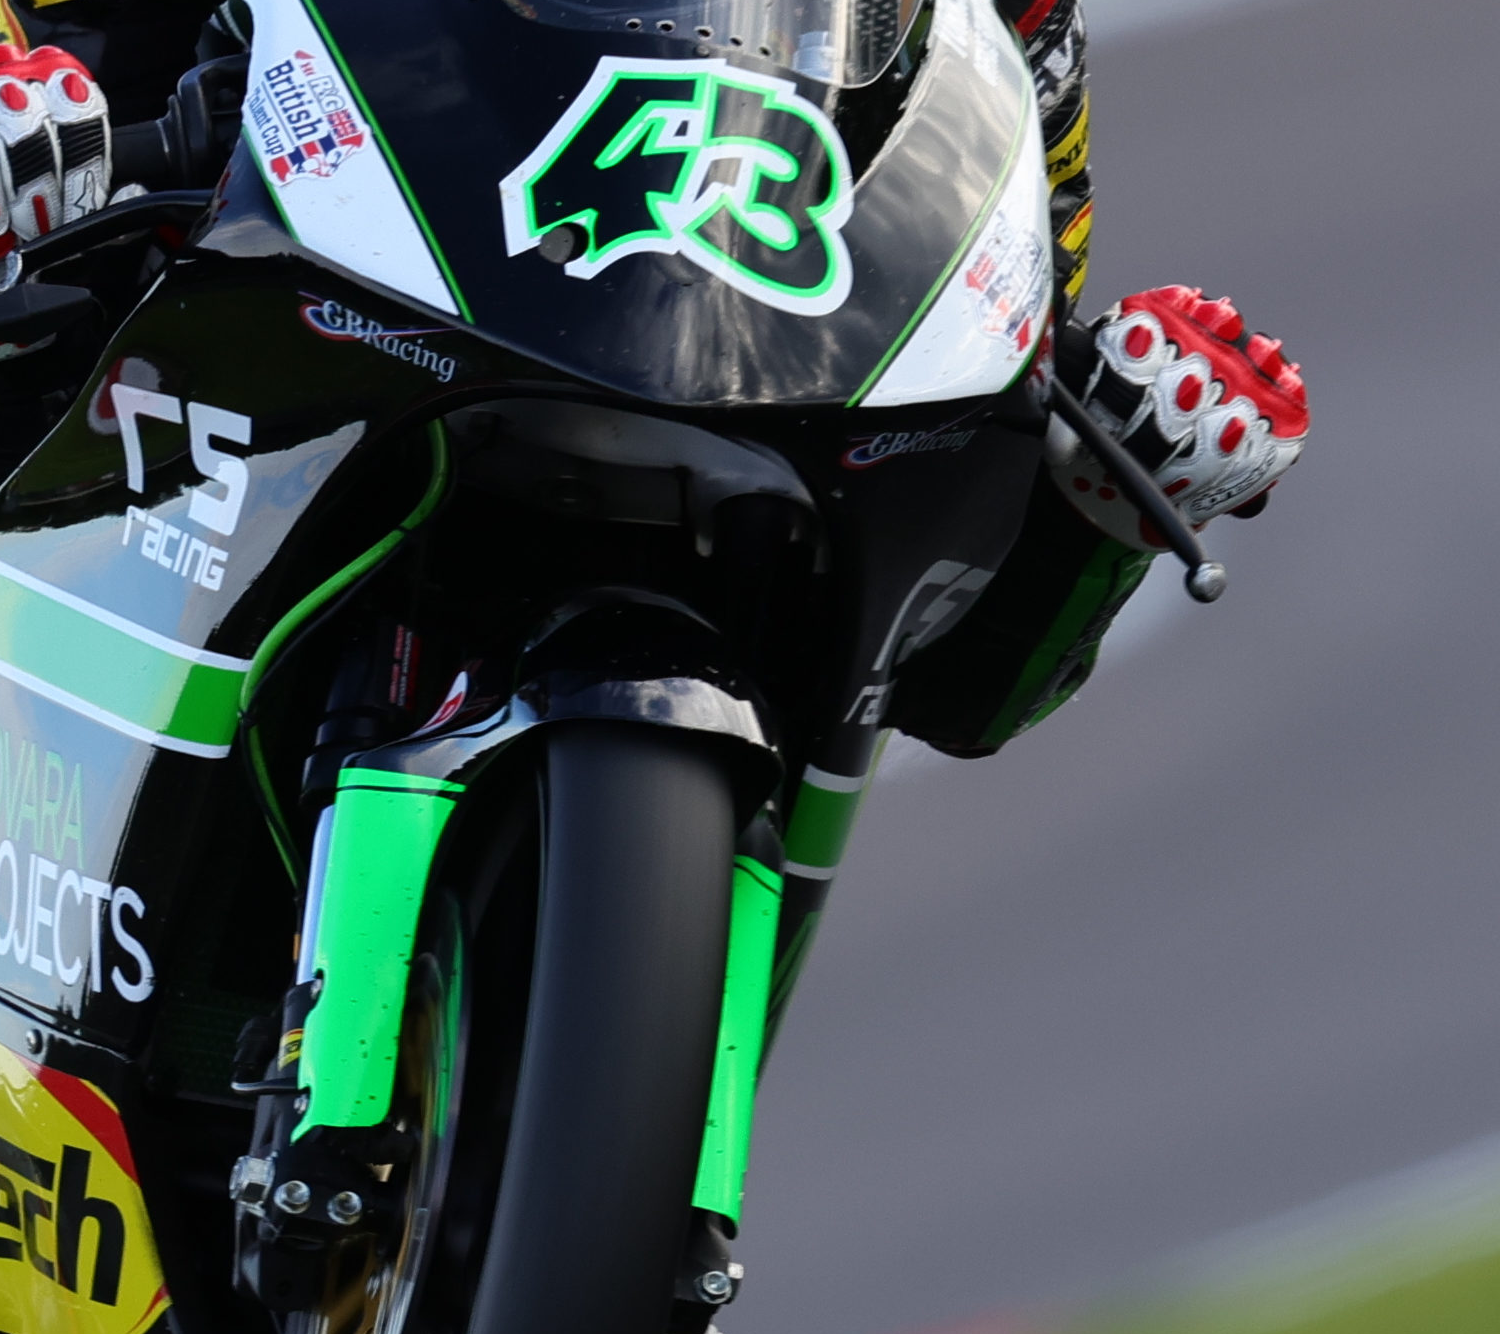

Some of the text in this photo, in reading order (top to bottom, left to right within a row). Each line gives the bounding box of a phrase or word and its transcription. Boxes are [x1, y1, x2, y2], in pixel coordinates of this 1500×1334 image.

[244, 86, 285, 157] Talent Cup
[263, 59, 323, 140] British
[307, 74, 347, 115] R&G
[501, 57, 853, 317] 43
